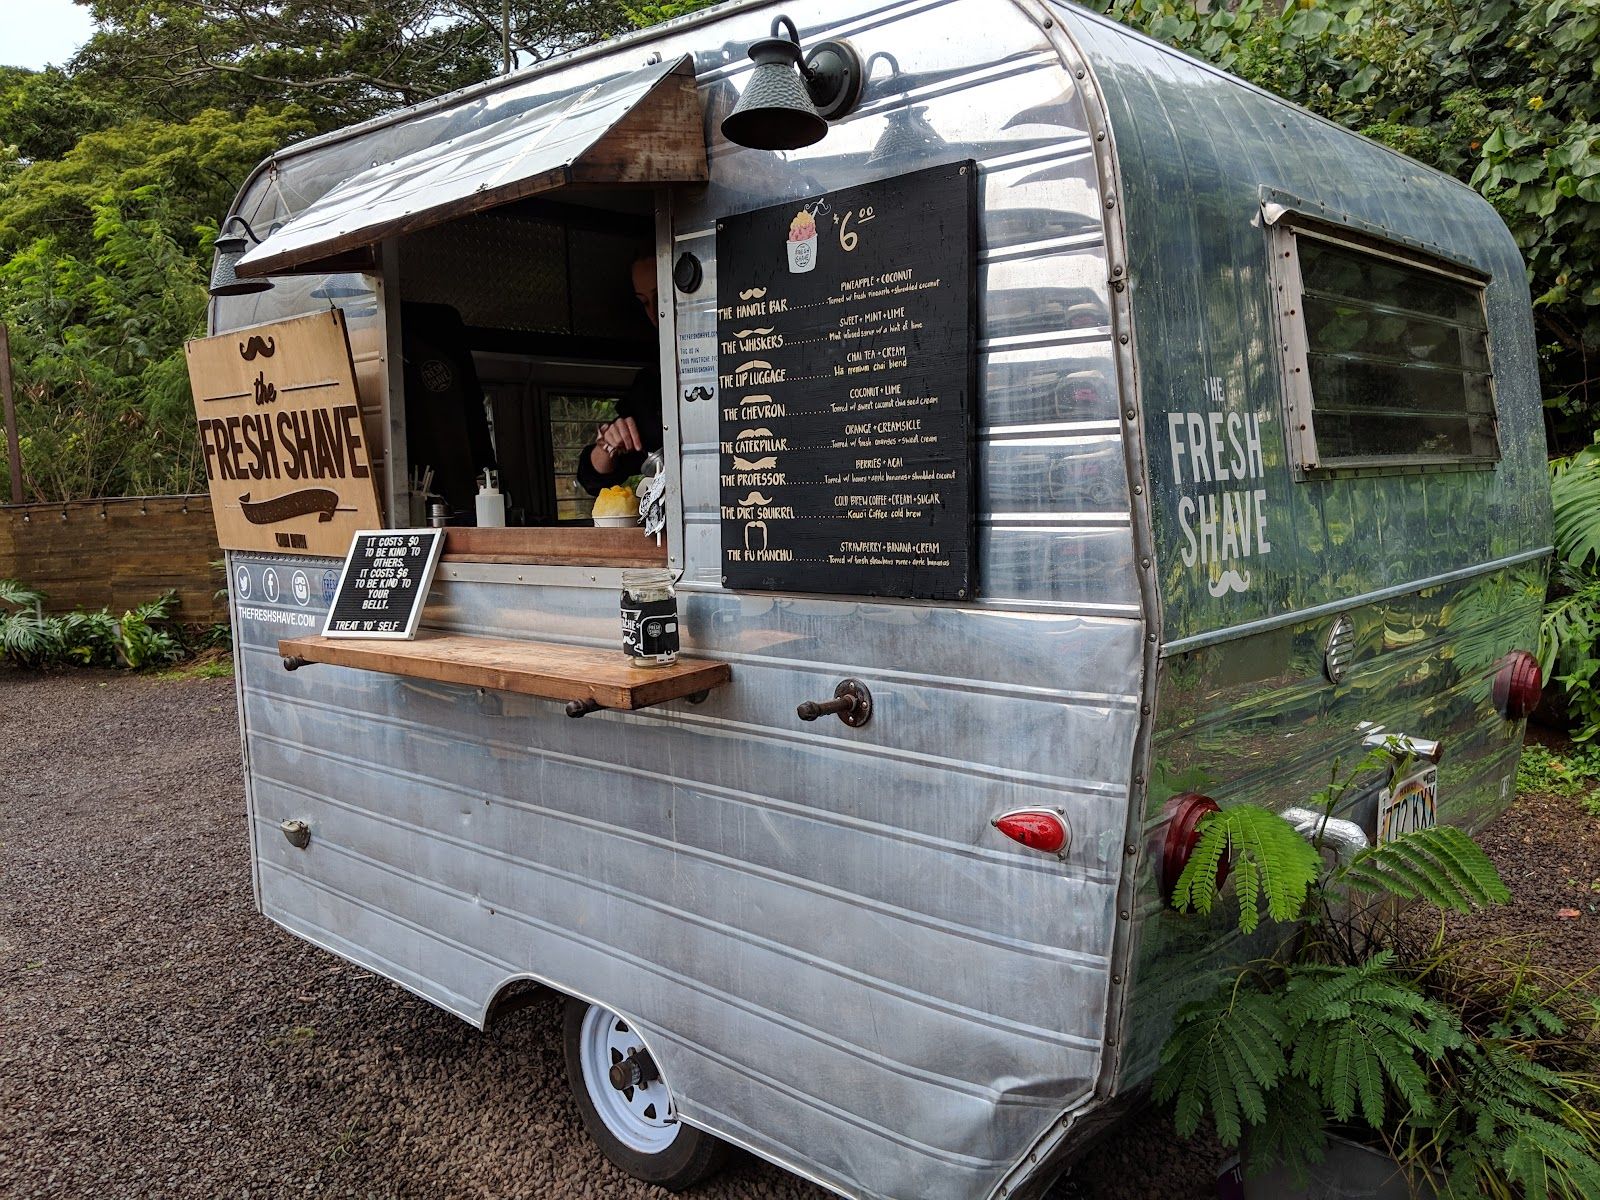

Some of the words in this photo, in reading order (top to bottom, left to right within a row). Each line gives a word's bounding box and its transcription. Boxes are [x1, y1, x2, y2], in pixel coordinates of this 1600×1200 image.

[841, 276, 874, 291] PINEAPPLE
[880, 269, 912, 283] COCONUT
[718, 307, 732, 320] THE
[737, 302, 766, 318] HANDLE
[769, 298, 788, 314] BAR
[840, 315, 859, 327] SWEET
[864, 311, 882, 323] MINT
[887, 307, 905, 319] LIME
[721, 341, 736, 354] THE
[740, 335, 783, 351] WHISKERS
[890, 324, 900, 332] hint
[847, 352, 862, 362] CHAI
[864, 350, 875, 360] TEA
[882, 346, 905, 358] CREAM
[719, 375, 733, 389] THE
[736, 372, 748, 387] LIP
[750, 369, 786, 385] LUGGAGE
[873, 362, 886, 372] chai
[889, 357, 907, 369] blend
[254, 371, 277, 405] the
[850, 386, 879, 399] COCONUT
[885, 384, 901, 395] LIME
[724, 408, 738, 421] THE
[742, 404, 785, 420] CHEVRON
[907, 396, 919, 406] seed
[845, 423, 871, 435] ORANGE
[877, 419, 921, 433] CREAMSICLE
[199, 413, 280, 480] FRESH
[276, 406, 369, 480] SHAVE
[721, 442, 733, 454] THE
[736, 438, 788, 453] CATERPILLAR
[1168, 412, 1264, 485] FRESH
[856, 458, 881, 469] BERRIES
[721, 475, 735, 487] THE
[738, 472, 786, 486] PROFESSOR
[834, 496, 848, 506] COLD
[850, 496, 868, 506] BREW
[868, 495, 887, 506] COFFEE
[892, 494, 912, 506] CREAM
[917, 493, 940, 505] SUGAR
[721, 506, 735, 520] THE
[737, 507, 754, 519] DIRT
[757, 507, 795, 520] SQUIRREL
[868, 509, 887, 519] Coffee
[891, 508, 903, 518] cold
[906, 508, 921, 518] brew
[1179, 489, 1270, 568] SHAVE
[367, 538, 377, 547] IT
[379, 537, 403, 546] COSTS
[408, 536, 419, 547] $0
[840, 542, 881, 552] STRAWBERRY
[887, 542, 911, 553] BANANA
[916, 542, 940, 554] CREAM
[365, 548, 374, 557] TO
[376, 548, 388, 557] BE
[388, 547, 407, 557] KIND
[411, 547, 420, 556] TO
[728, 550, 741, 561] THE
[745, 549, 755, 561] FU
[757, 550, 793, 561] MANCHU
[373, 558, 404, 567] OTHERS.
[360, 569, 369, 578] IT
[370, 568, 395, 578] COSTS
[397, 568, 408, 579] $6
[355, 579, 365, 588] TO
[367, 579, 379, 588] BE
[380, 578, 398, 588] KIND
[402, 579, 412, 588] TO
[368, 589, 389, 598] YOUR
[362, 600, 389, 610] BELLY.
[238, 606, 315, 627] THEFRESHSHAVE.COM
[336, 621, 360, 630] TREAT
[378, 621, 399, 631] SELF
